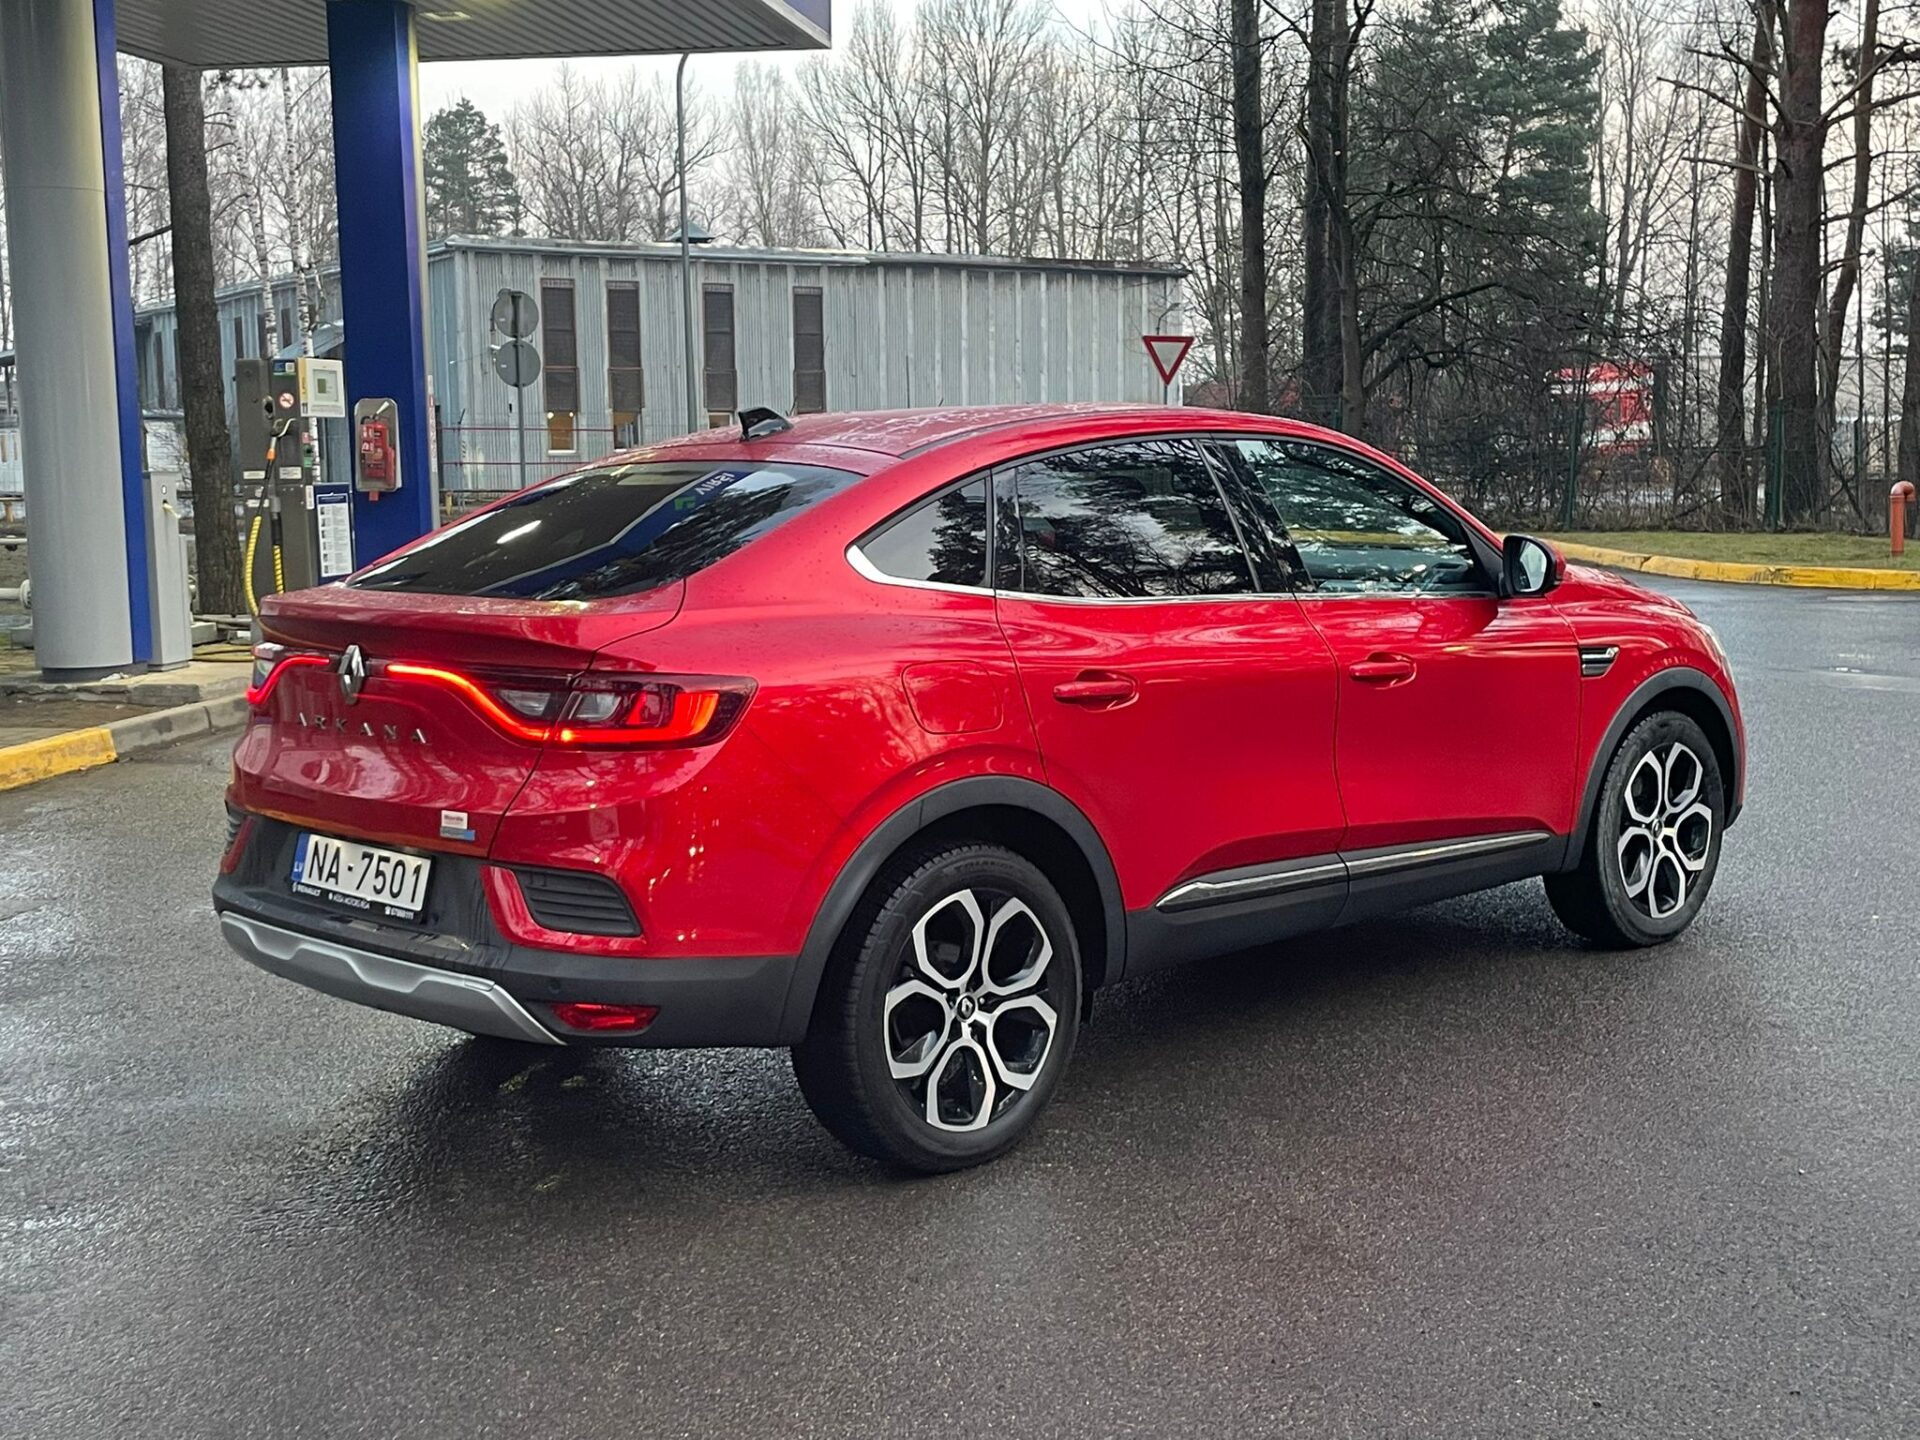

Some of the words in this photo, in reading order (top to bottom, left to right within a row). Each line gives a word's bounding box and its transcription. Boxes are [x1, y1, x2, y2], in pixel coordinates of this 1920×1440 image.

[298, 712, 428, 745] ARKANA
[293, 861, 304, 873] LV
[308, 840, 423, 904] NA-7501
